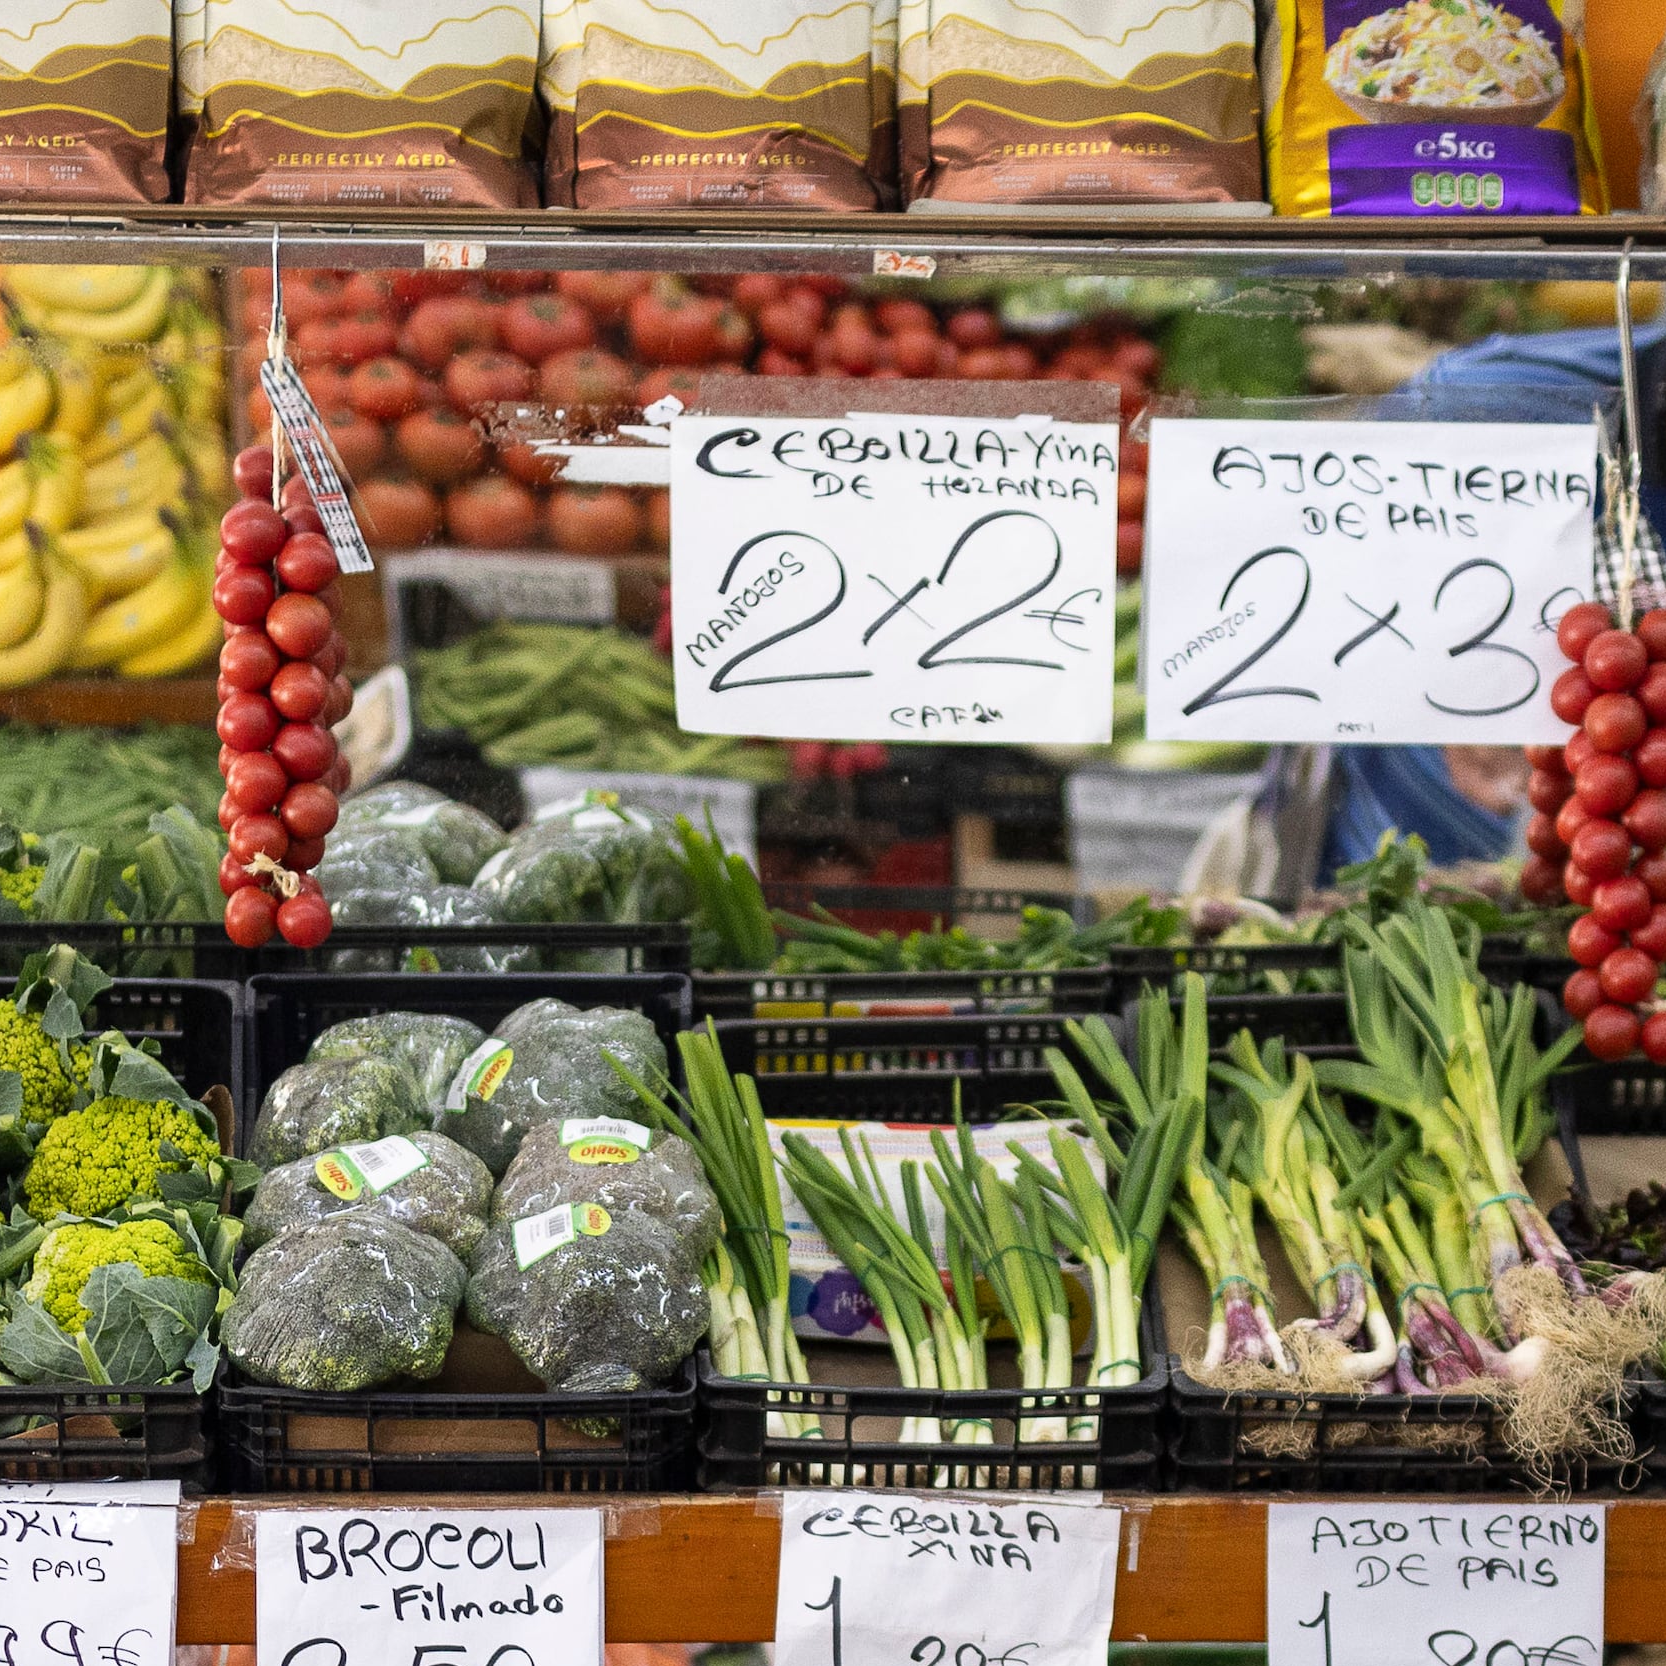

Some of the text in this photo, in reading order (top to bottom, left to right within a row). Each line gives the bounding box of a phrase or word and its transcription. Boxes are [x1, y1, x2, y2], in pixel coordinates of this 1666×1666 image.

[813, 471, 874, 499] DE
[1302, 502, 1479, 539] DE PAIS
[295, 1517, 547, 1584] BROCOLI
[32, 1556, 106, 1582] PAIS
[1355, 1553, 1560, 1589] DE PAIS
